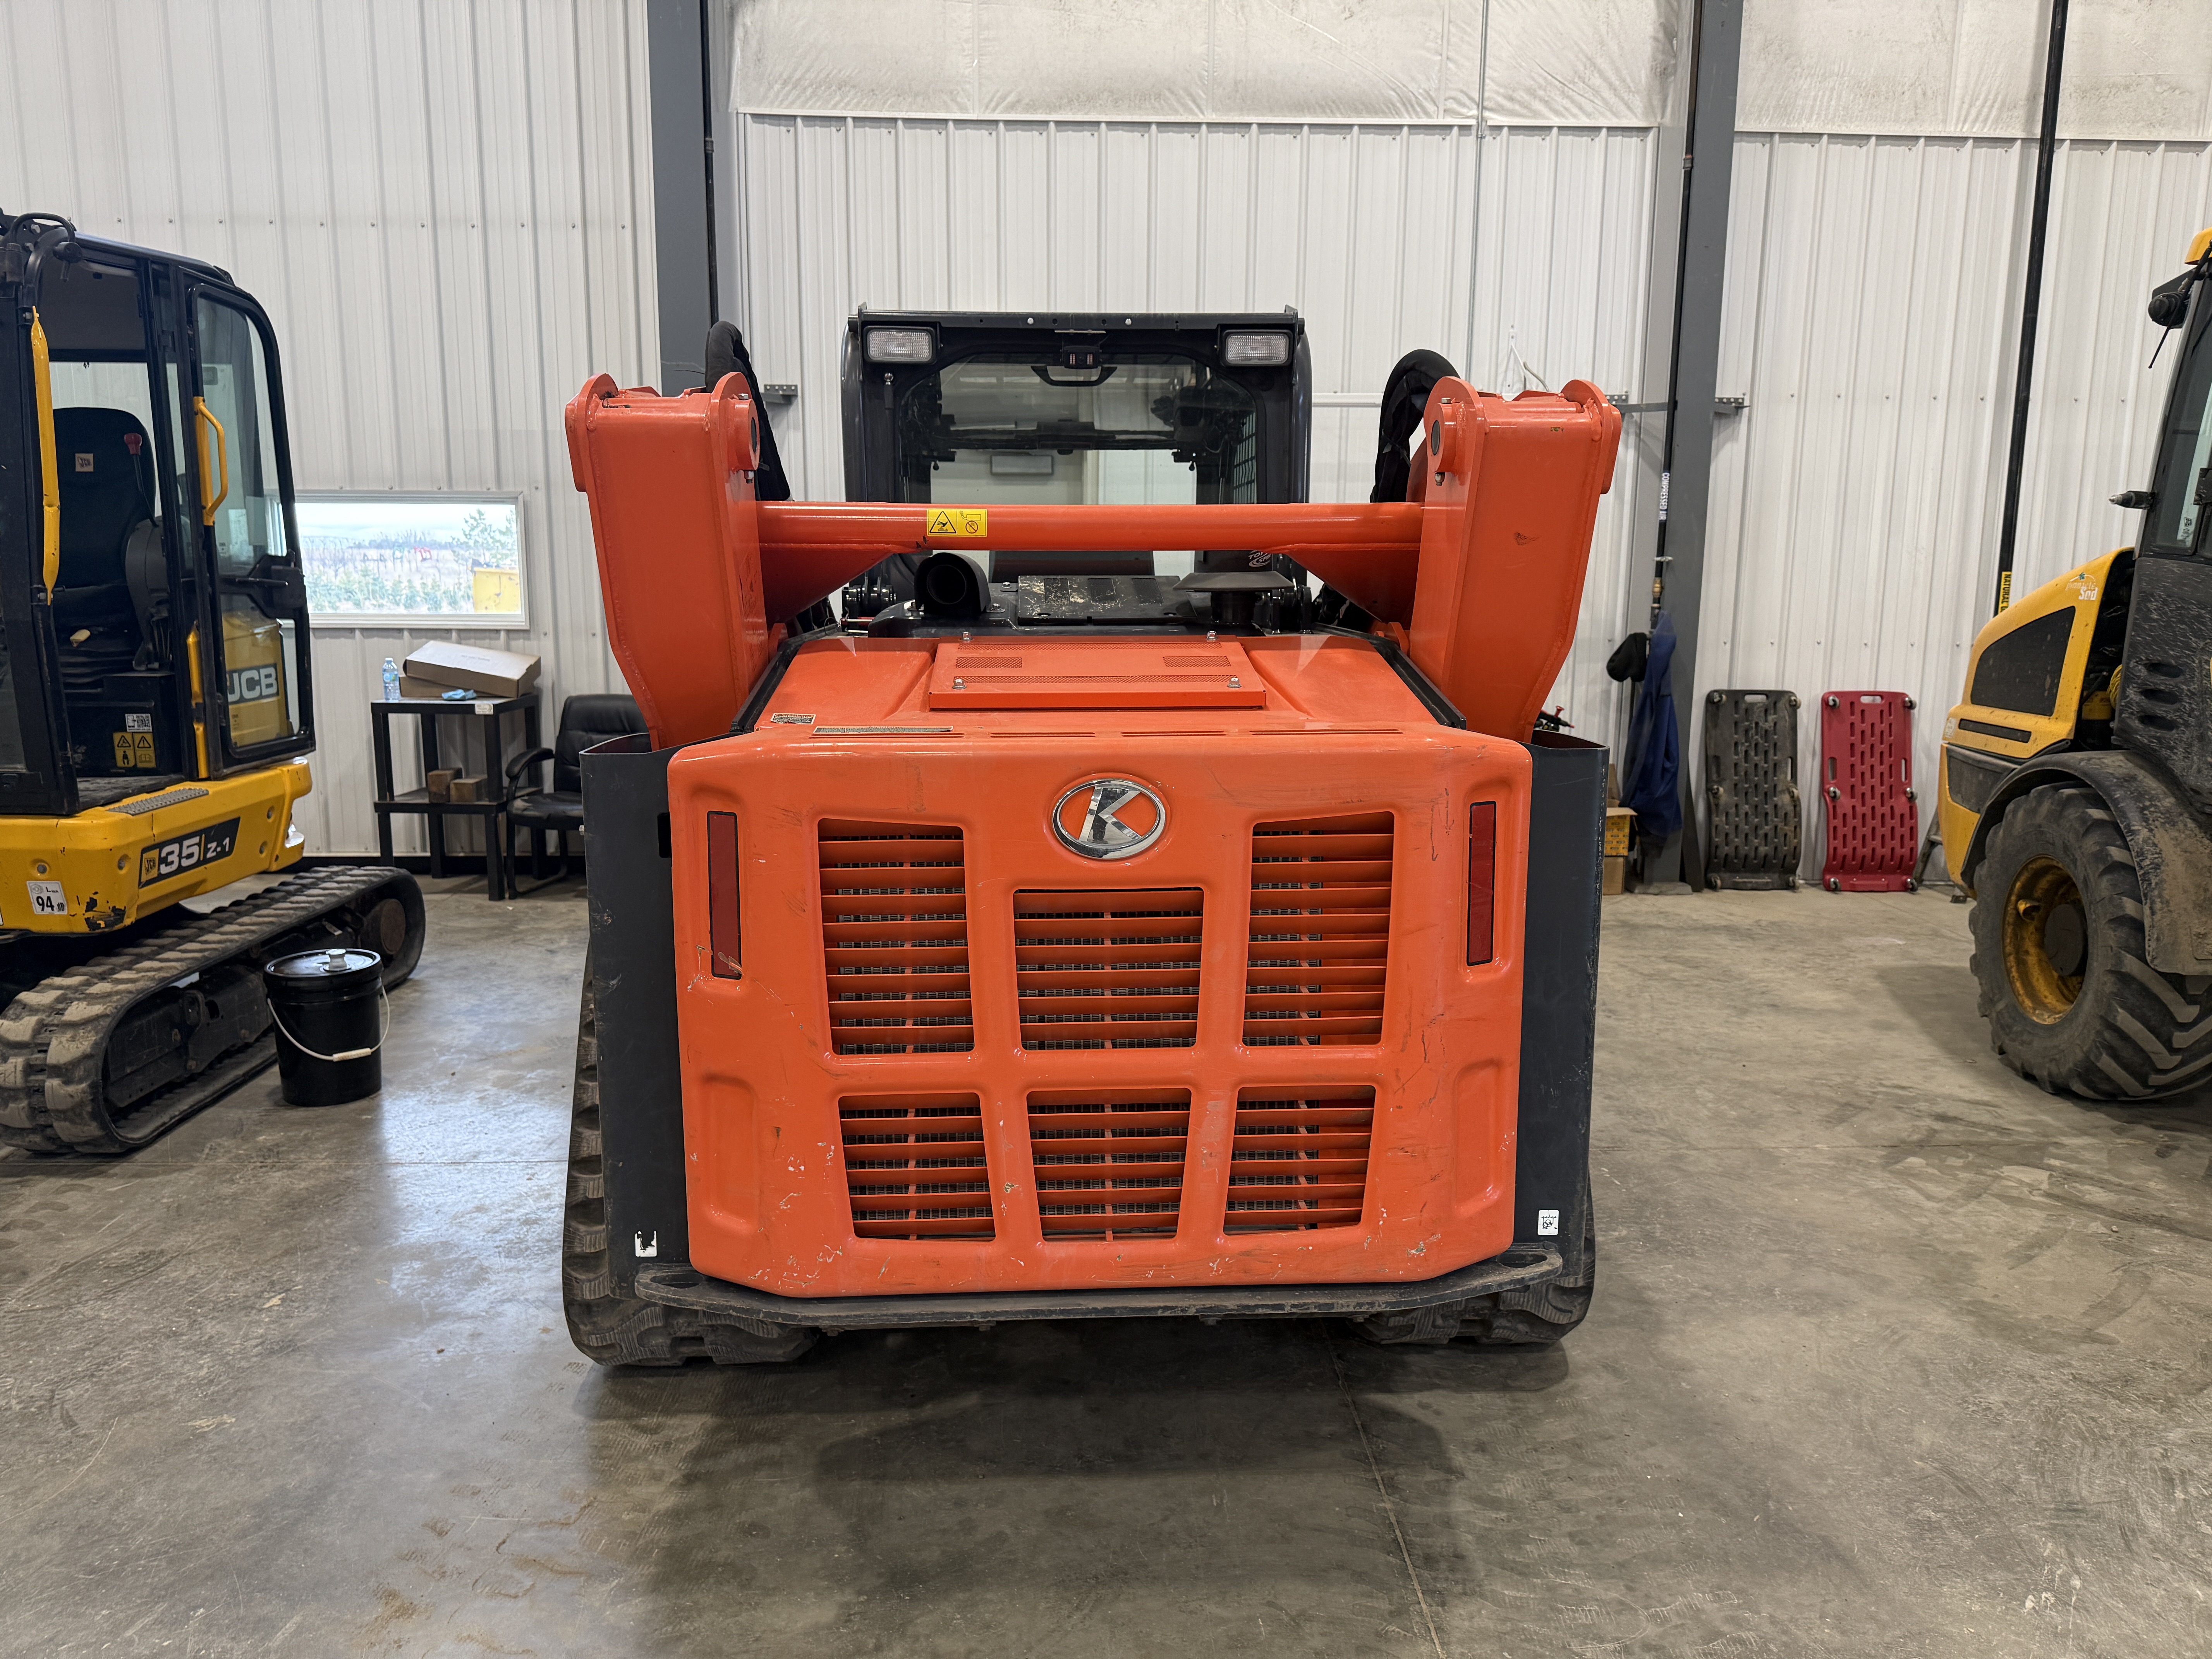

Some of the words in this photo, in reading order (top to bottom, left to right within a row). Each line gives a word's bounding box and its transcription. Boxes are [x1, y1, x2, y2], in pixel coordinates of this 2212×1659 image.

[1659, 472, 1670, 510] COMPRESSED
[2001, 574, 2011, 604] NATURAL
[2078, 586, 2098, 601] Sod
[228, 667, 278, 702] JCB
[160, 836, 200, 874] 35
[36, 896, 55, 911] 94
